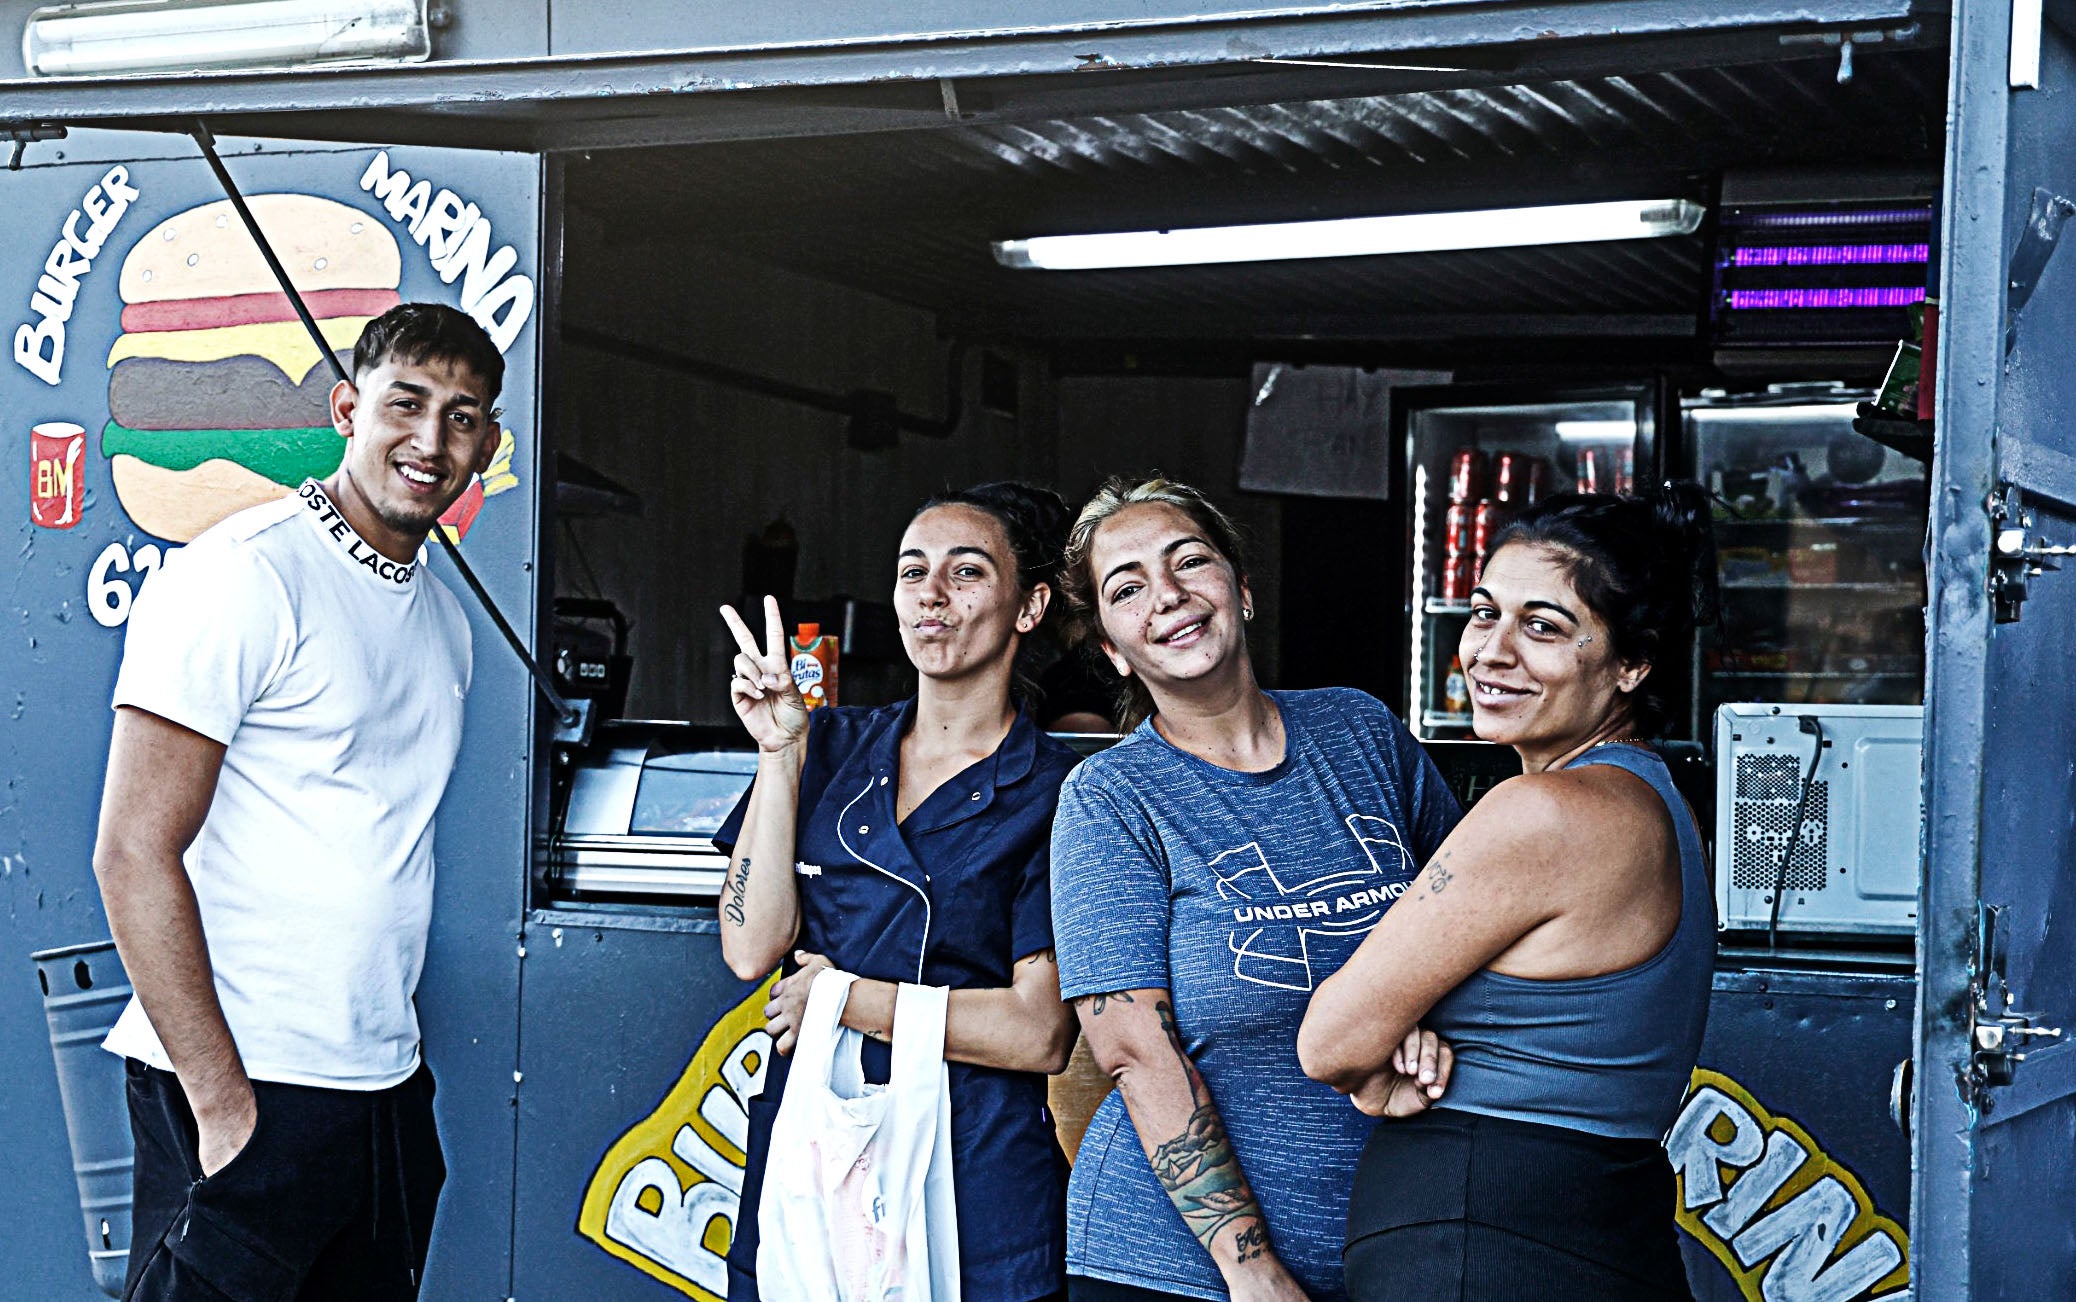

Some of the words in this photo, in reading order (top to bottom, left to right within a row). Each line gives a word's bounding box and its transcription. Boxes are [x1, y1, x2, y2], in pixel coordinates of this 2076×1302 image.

[14, 165, 140, 386] BURGER
[360, 150, 535, 355] MARINO
[37, 458, 74, 498] BM
[87, 542, 163, 627] 62
[724, 857, 752, 927] Dolores
[1233, 901, 1332, 922] UNDER
[605, 1030, 773, 1299] BUR
[1667, 1087, 1909, 1302] RIN
